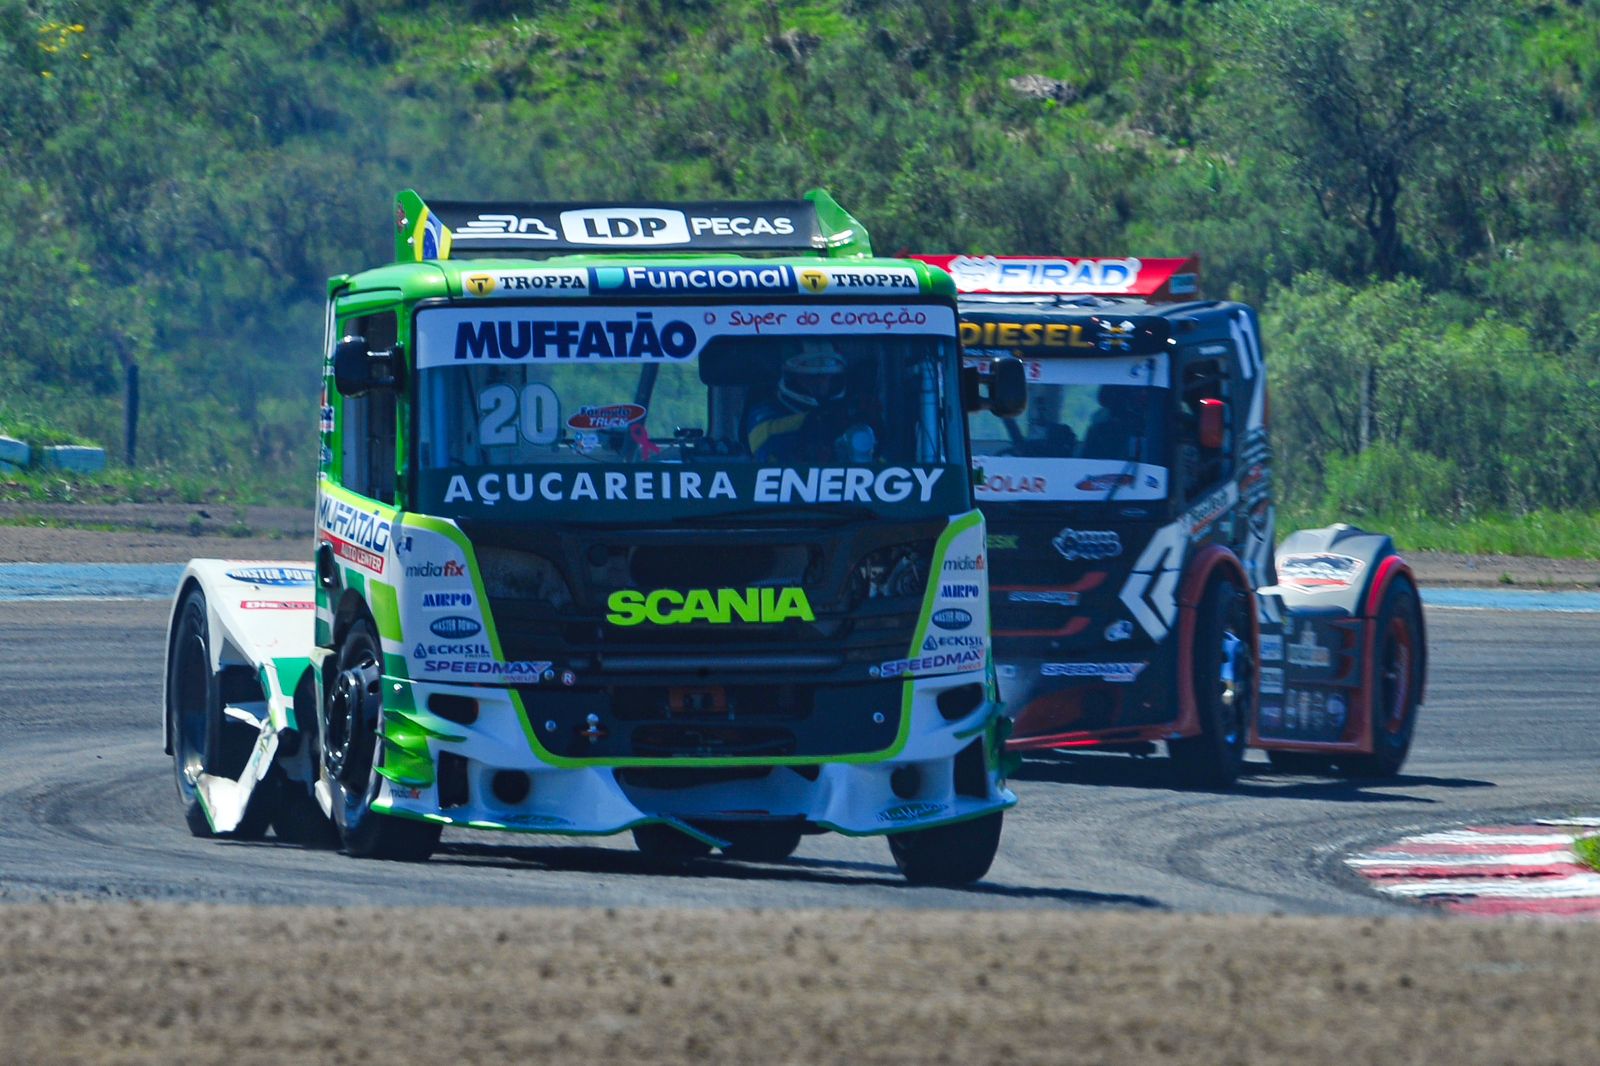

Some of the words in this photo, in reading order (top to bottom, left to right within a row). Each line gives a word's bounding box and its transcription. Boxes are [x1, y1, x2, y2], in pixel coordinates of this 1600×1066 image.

[583, 217, 667, 238] LDP
[690, 216, 795, 237] PEÇAS
[500, 276, 586, 290] TROPPA
[627, 265, 790, 288] Funcional
[832, 273, 916, 288] TROPPA
[1000, 263, 1131, 287] FIRAD
[796, 310, 821, 326] do
[831, 308, 927, 330] coração
[959, 321, 1092, 347] DIESEL
[478, 383, 561, 446] 20
[443, 471, 738, 505] AÇUCAREIRA
[753, 467, 945, 502] ENERGY
[606, 587, 816, 627] SCANIA
[424, 660, 538, 674] SPEEDMAX
[881, 650, 981, 673] SPEEDMAX
